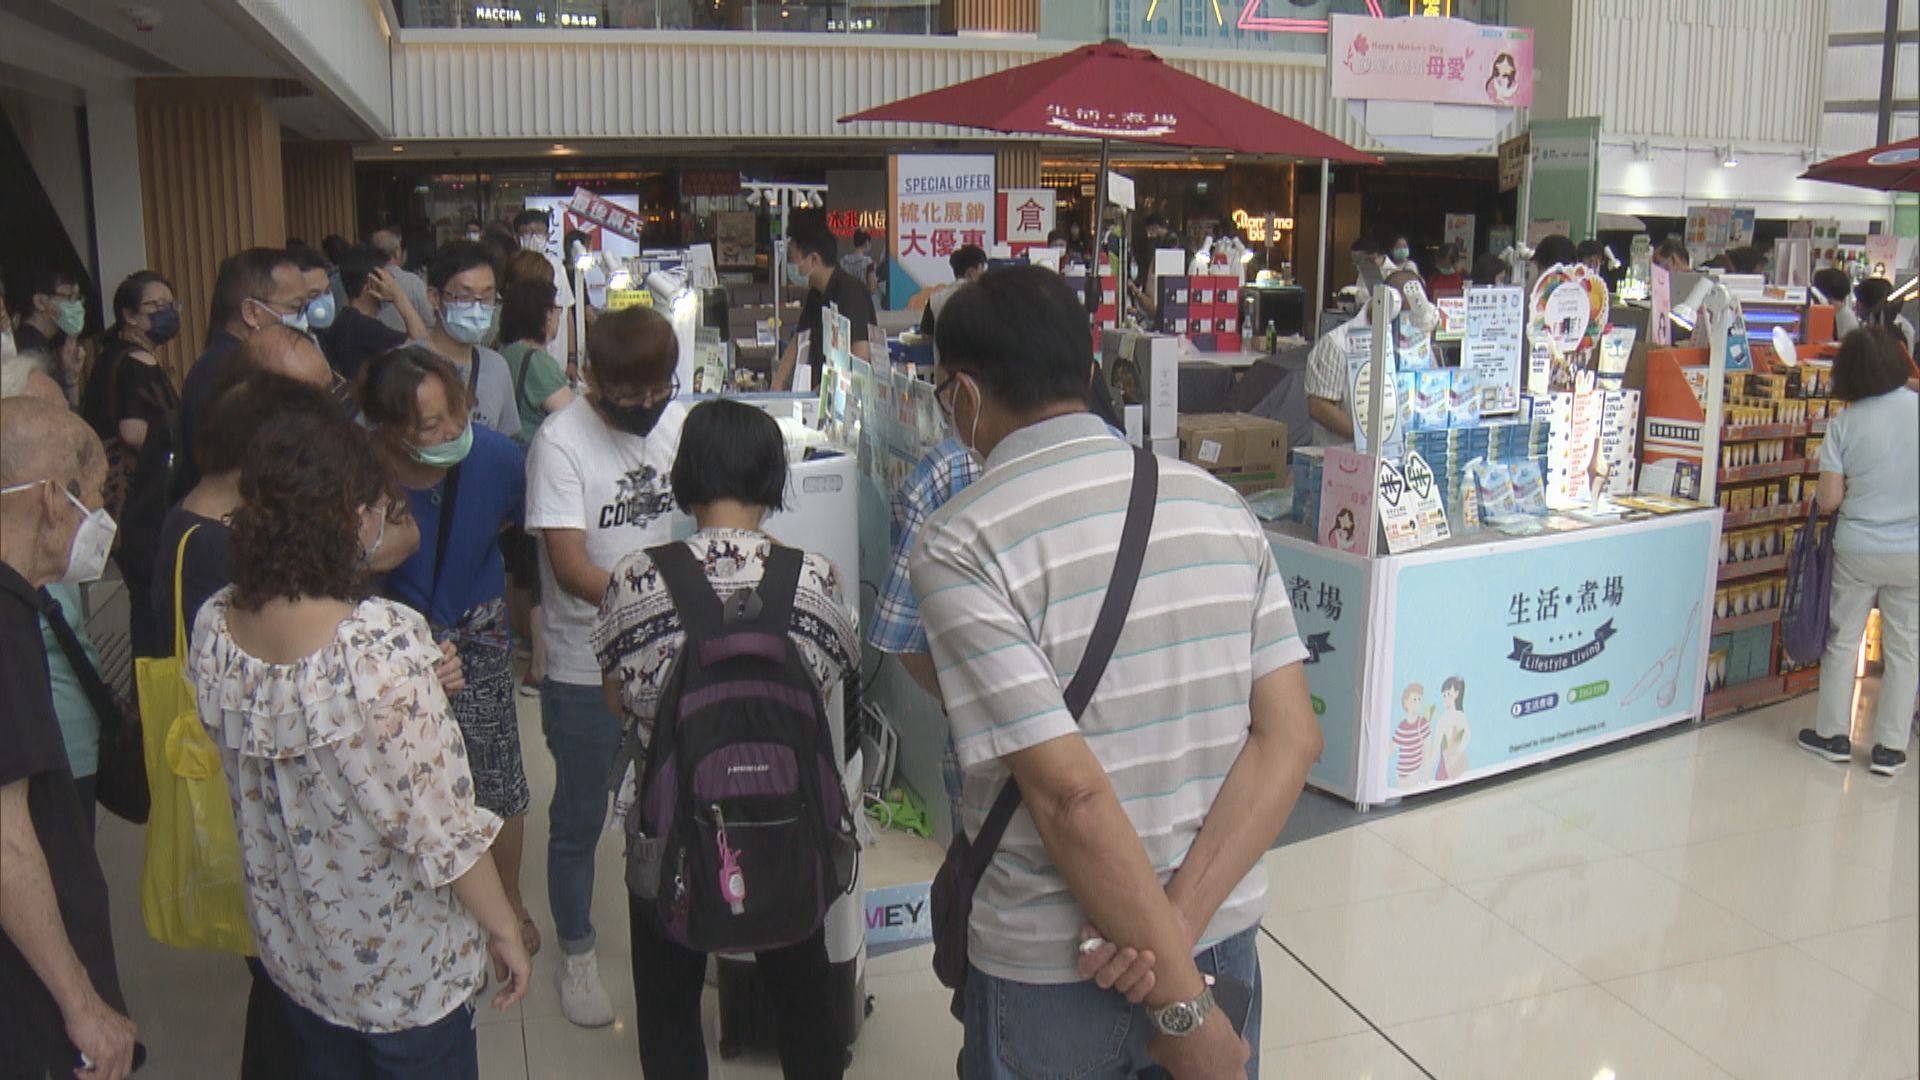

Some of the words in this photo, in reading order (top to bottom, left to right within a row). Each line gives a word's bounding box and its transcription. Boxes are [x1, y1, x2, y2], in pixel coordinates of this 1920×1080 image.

[905, 176, 951, 193] SPECIAL
[955, 173, 990, 190] OFFER
[900, 202, 985, 224] 梳化展銷
[1016, 197, 1045, 232] 倉
[1525, 657, 1568, 671] Lifestyle
[1571, 641, 1601, 666] Living
